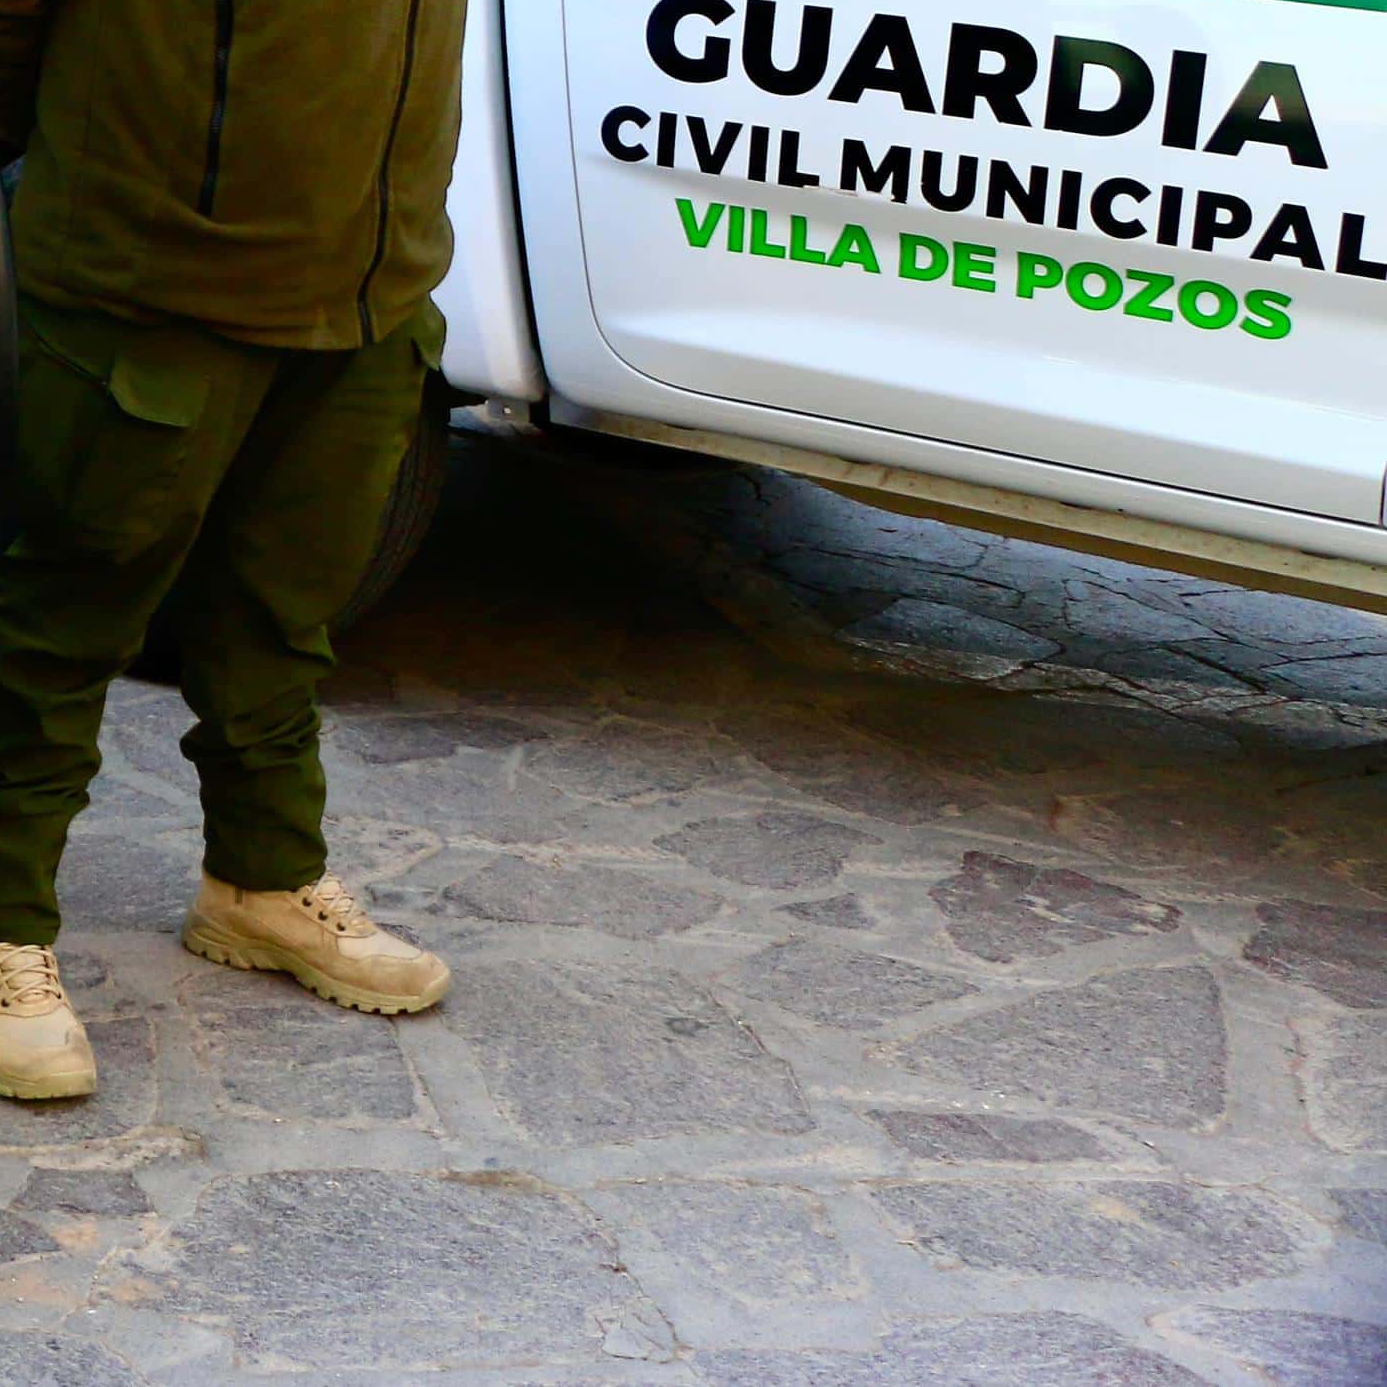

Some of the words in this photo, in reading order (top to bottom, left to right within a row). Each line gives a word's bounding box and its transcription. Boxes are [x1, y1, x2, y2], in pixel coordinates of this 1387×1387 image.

[599, 106, 821, 189] CIVIL
[838, 138, 1387, 281] MUNICIPAL
[674, 198, 881, 274] VILLA
[898, 234, 997, 294] DE
[1016, 253, 1294, 342] POZOS
